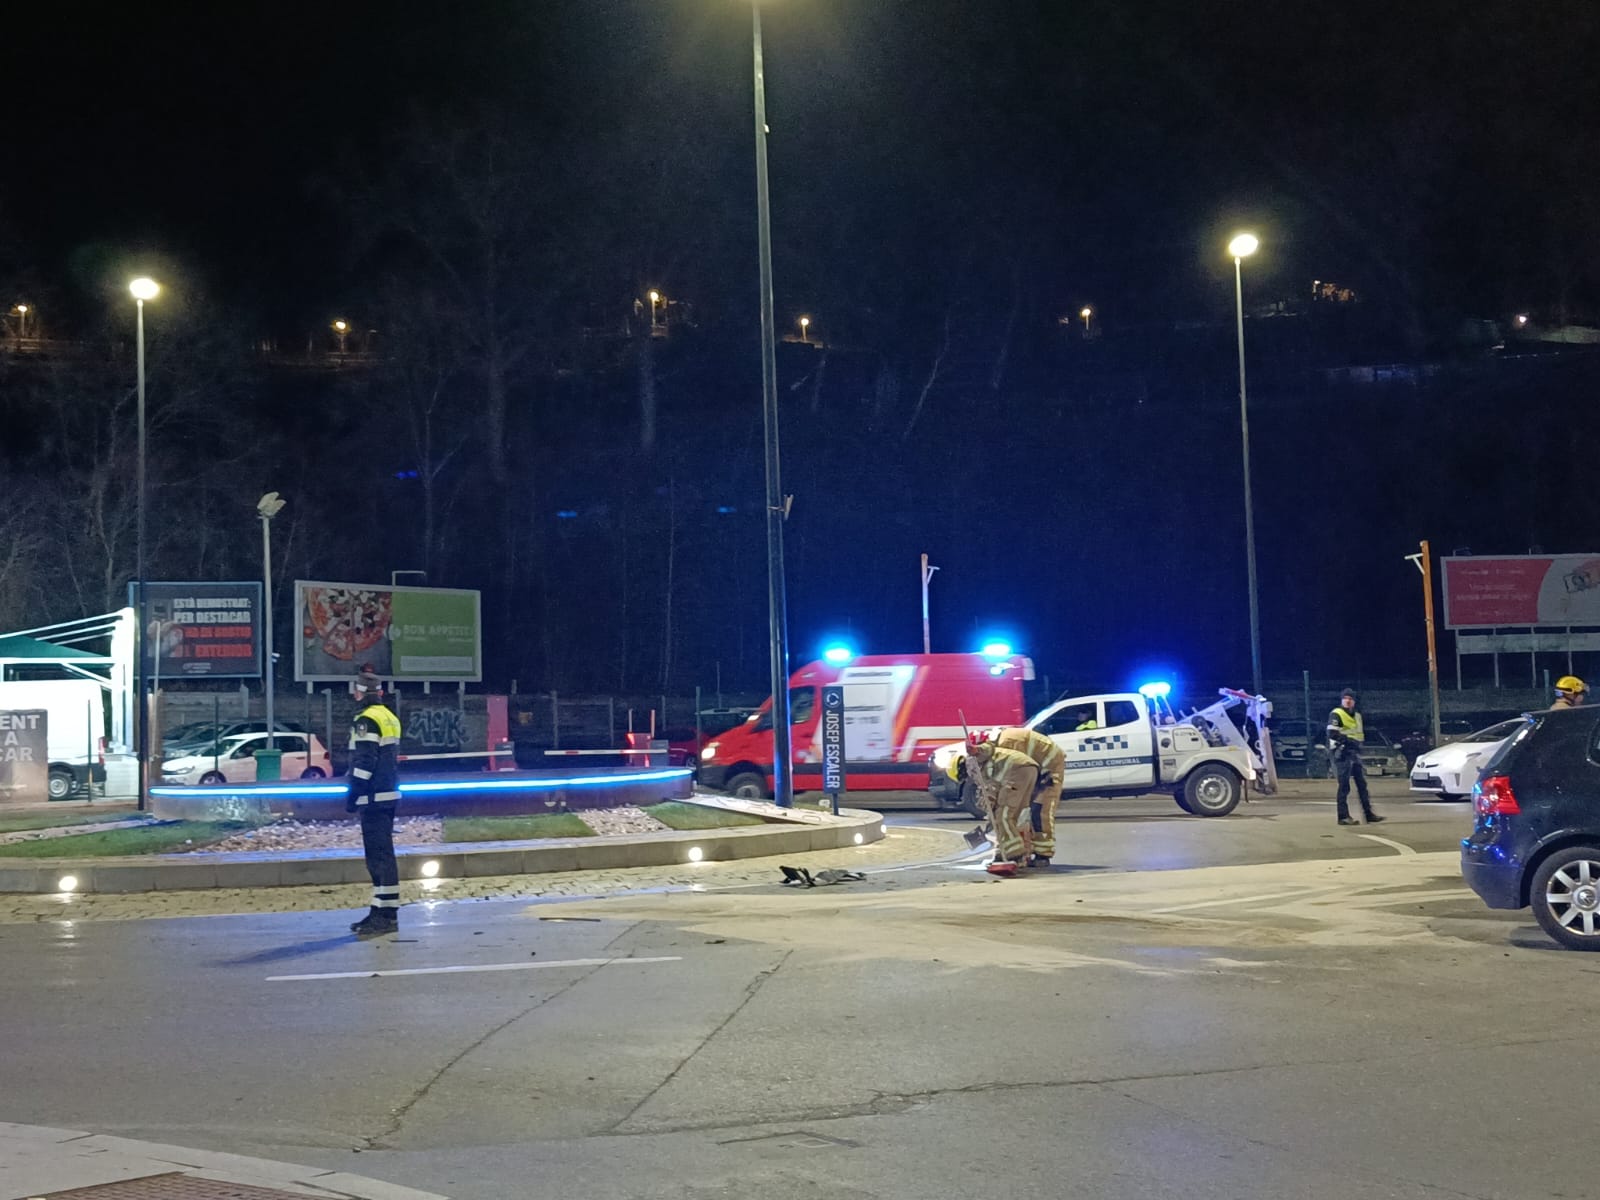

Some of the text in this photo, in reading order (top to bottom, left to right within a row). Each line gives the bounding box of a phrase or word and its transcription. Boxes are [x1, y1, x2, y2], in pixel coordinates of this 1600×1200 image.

[173, 611, 251, 623] PER DESTACAR
[0, 715, 40, 730] ENT
[4, 731, 18, 745] A
[826, 711, 841, 787] JOSEP ESCALER
